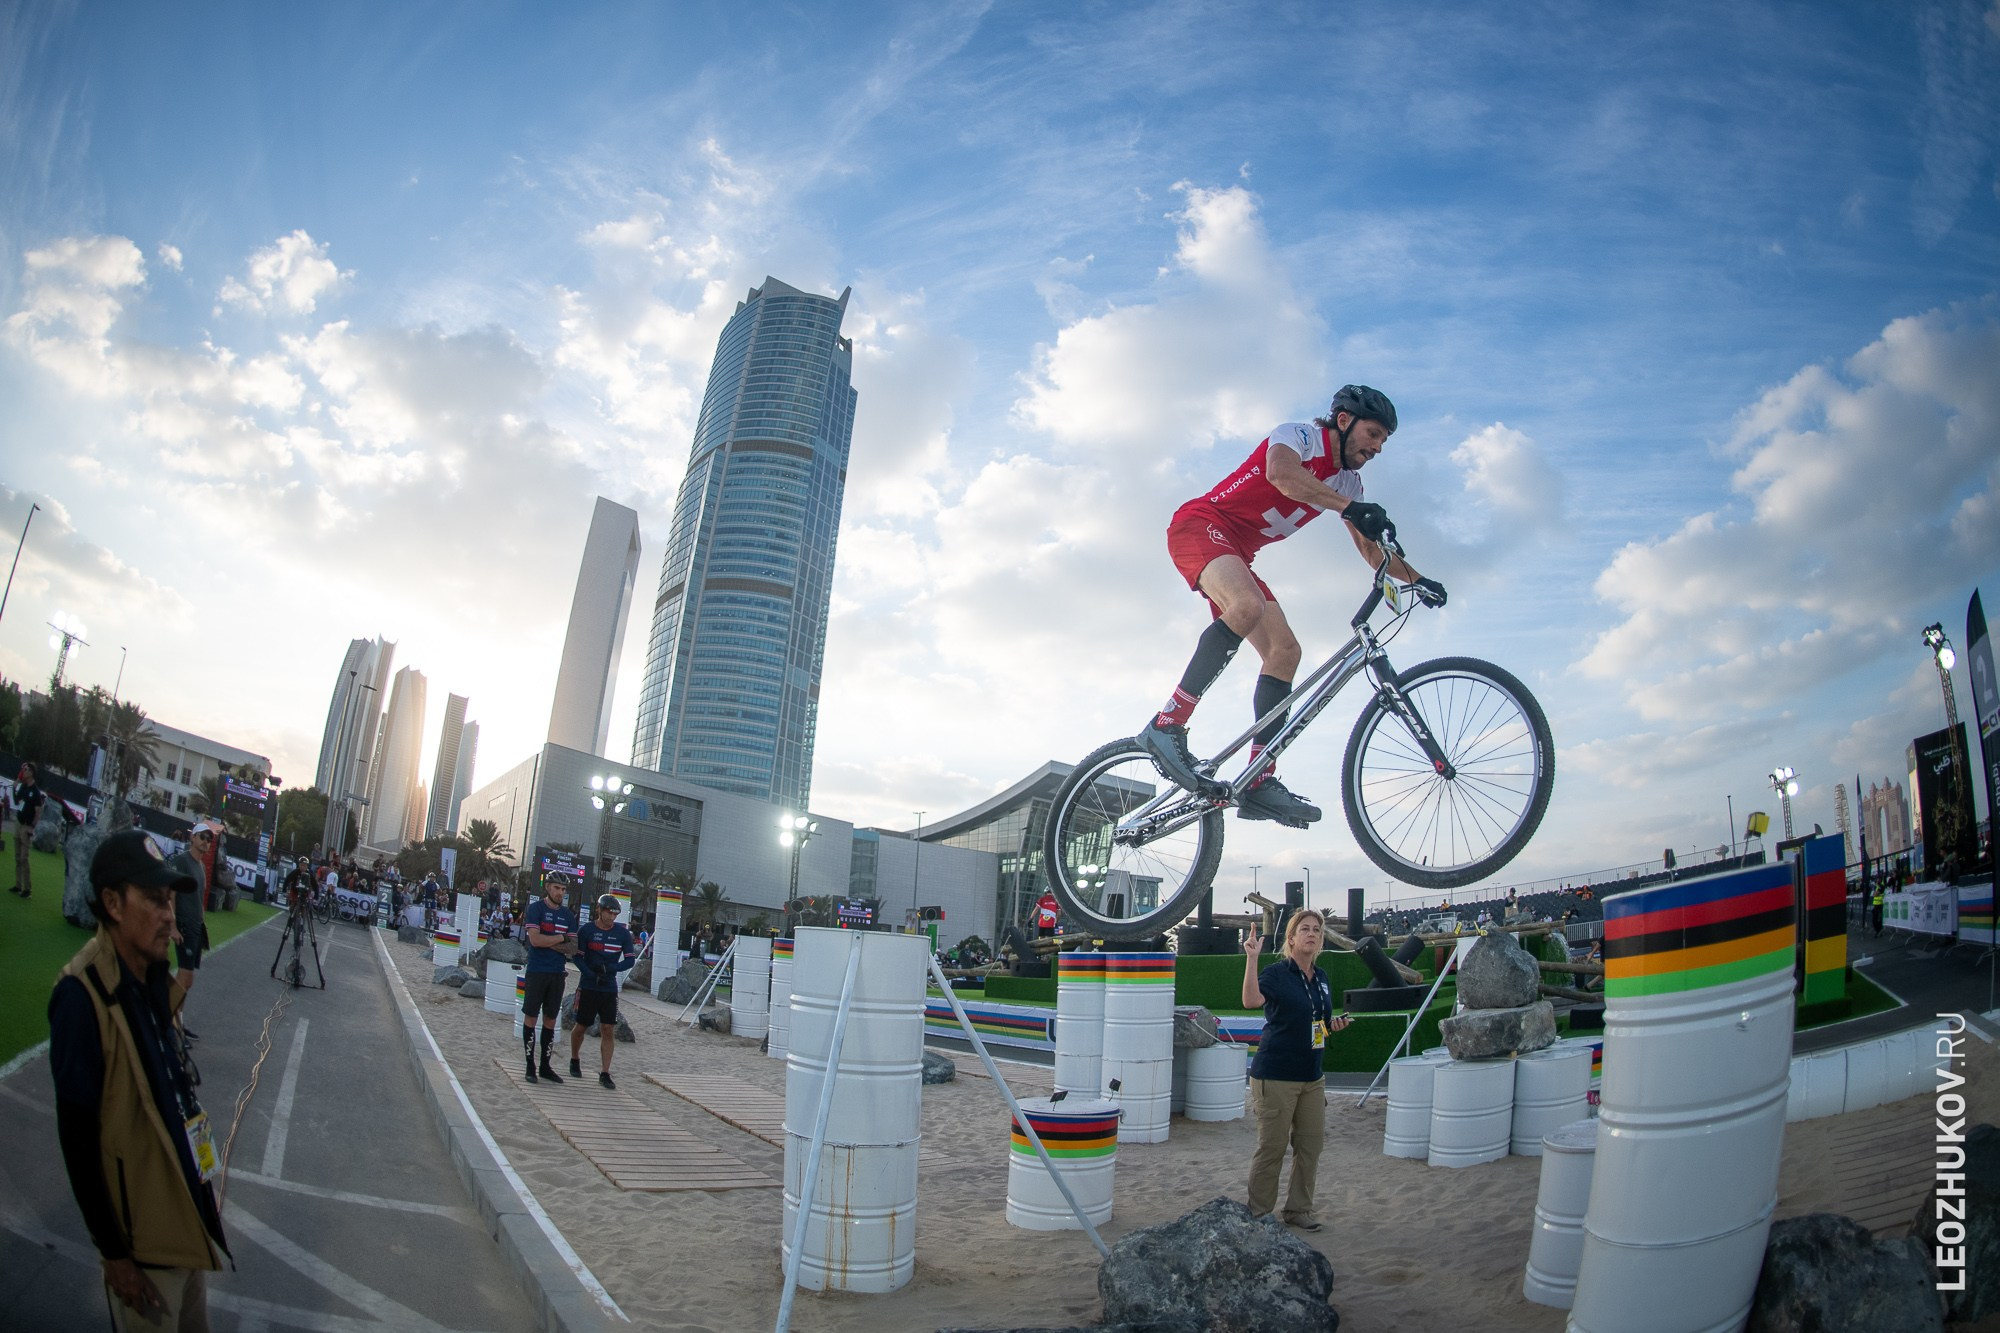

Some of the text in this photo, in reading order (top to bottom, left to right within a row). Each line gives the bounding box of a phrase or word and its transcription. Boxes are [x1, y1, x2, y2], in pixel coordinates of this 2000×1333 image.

[1219, 472, 1253, 499] TUDOR
[1976, 654, 1994, 704] 2
[1382, 681, 1428, 740] CLEAN
[651, 802, 683, 824] VOX
[1148, 802, 1197, 826] VORTEX
[226, 860, 257, 881] SOT
[381, 892, 388, 903] 2
